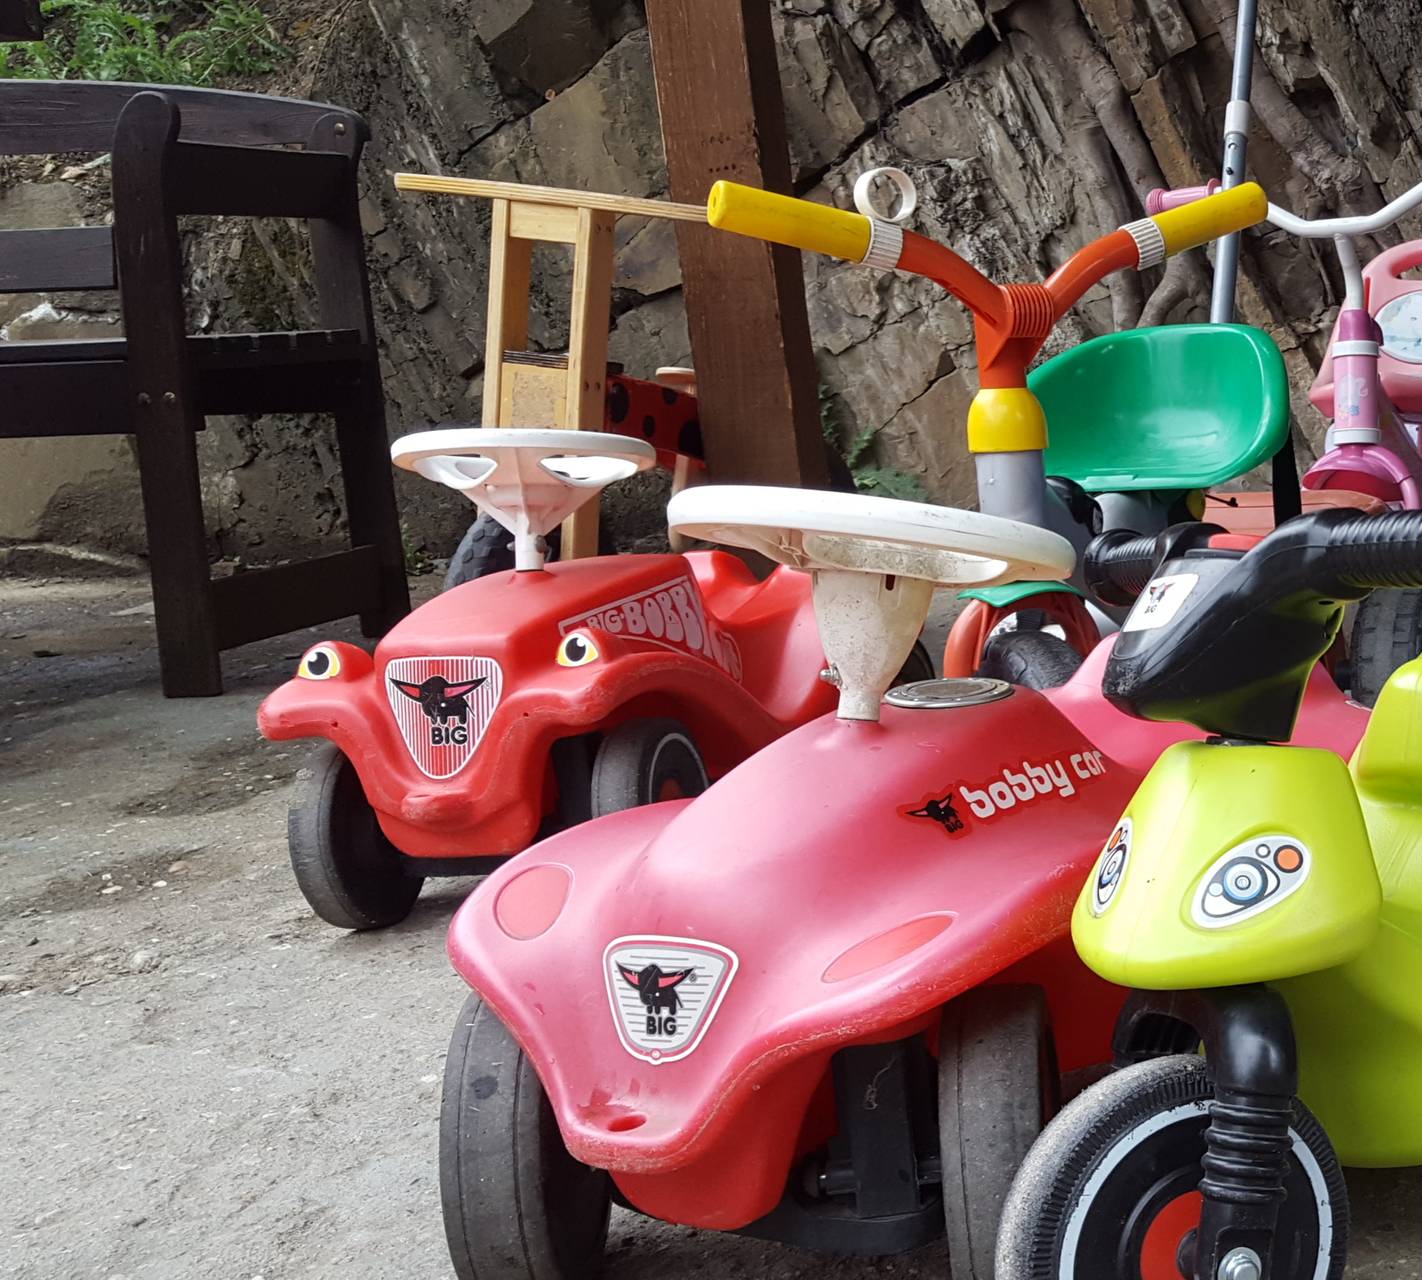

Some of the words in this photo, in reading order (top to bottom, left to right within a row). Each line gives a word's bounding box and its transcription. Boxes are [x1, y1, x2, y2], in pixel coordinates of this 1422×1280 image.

[431, 726, 468, 745] BIG
[959, 761, 1076, 819] bobby
[1069, 750, 1106, 780] car
[944, 819, 964, 833] BIG
[646, 1015, 677, 1036] BIG
